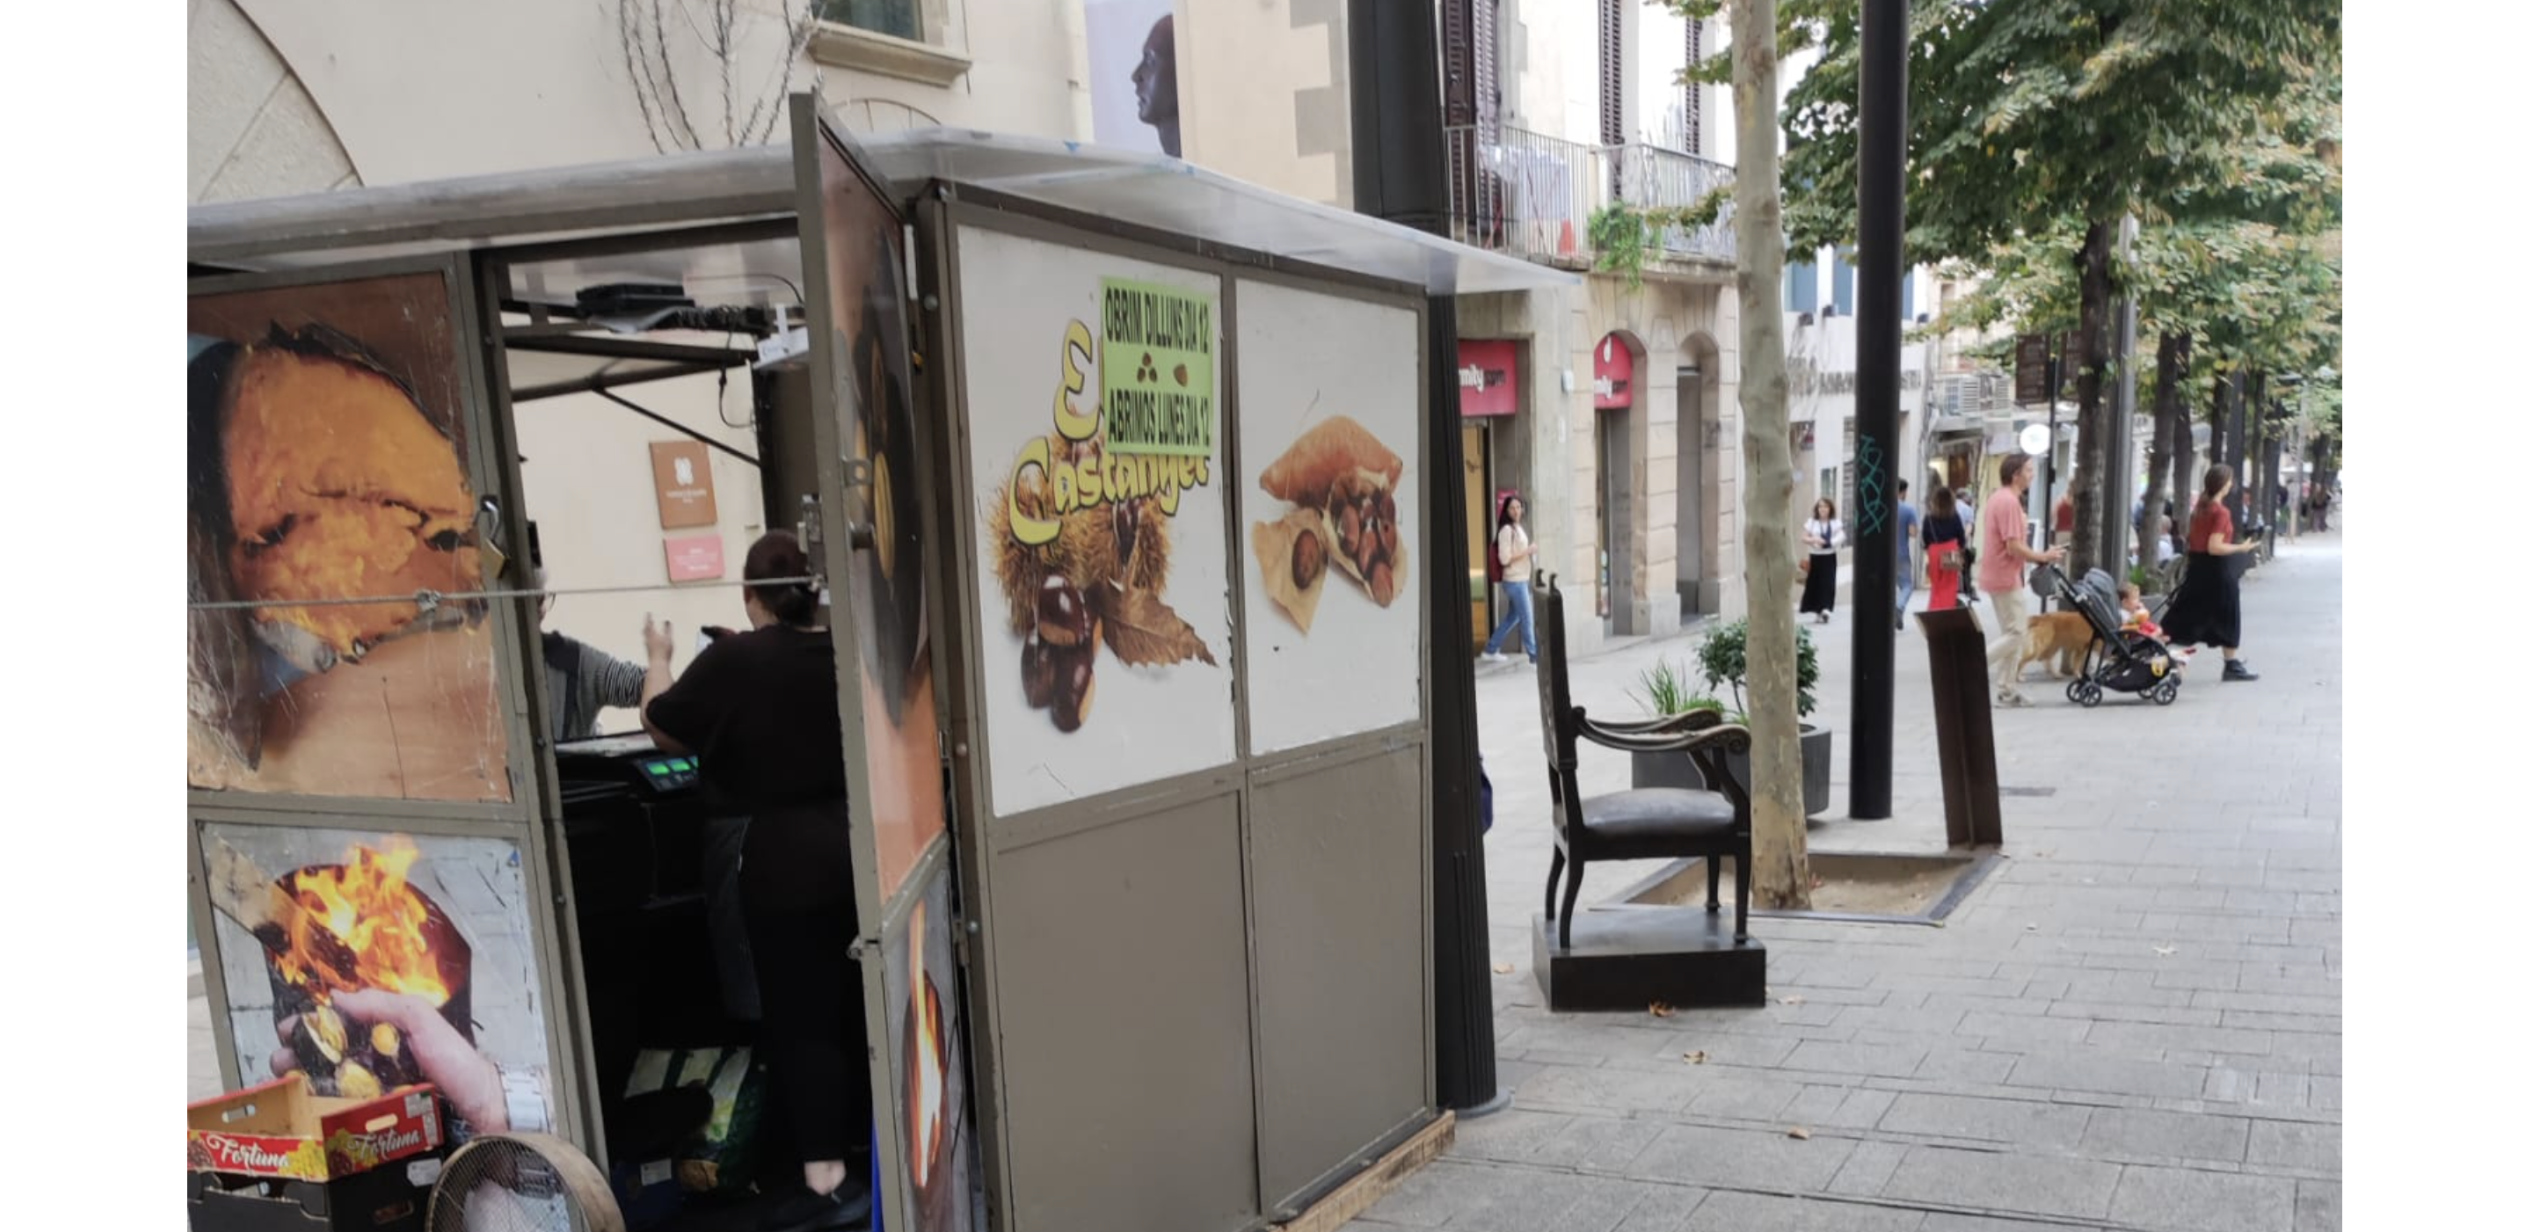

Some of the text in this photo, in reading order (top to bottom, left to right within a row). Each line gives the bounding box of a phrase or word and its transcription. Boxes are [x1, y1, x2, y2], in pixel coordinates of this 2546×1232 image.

[1105, 286, 1209, 354] OBRIM DILLUNS DIA 12
[1054, 318, 1104, 440] E
[1108, 387, 1210, 448] ABRIMOS LUNES DIA 12
[206, 1133, 290, 1172] Fortuna
[347, 1128, 421, 1162] Fortuna
